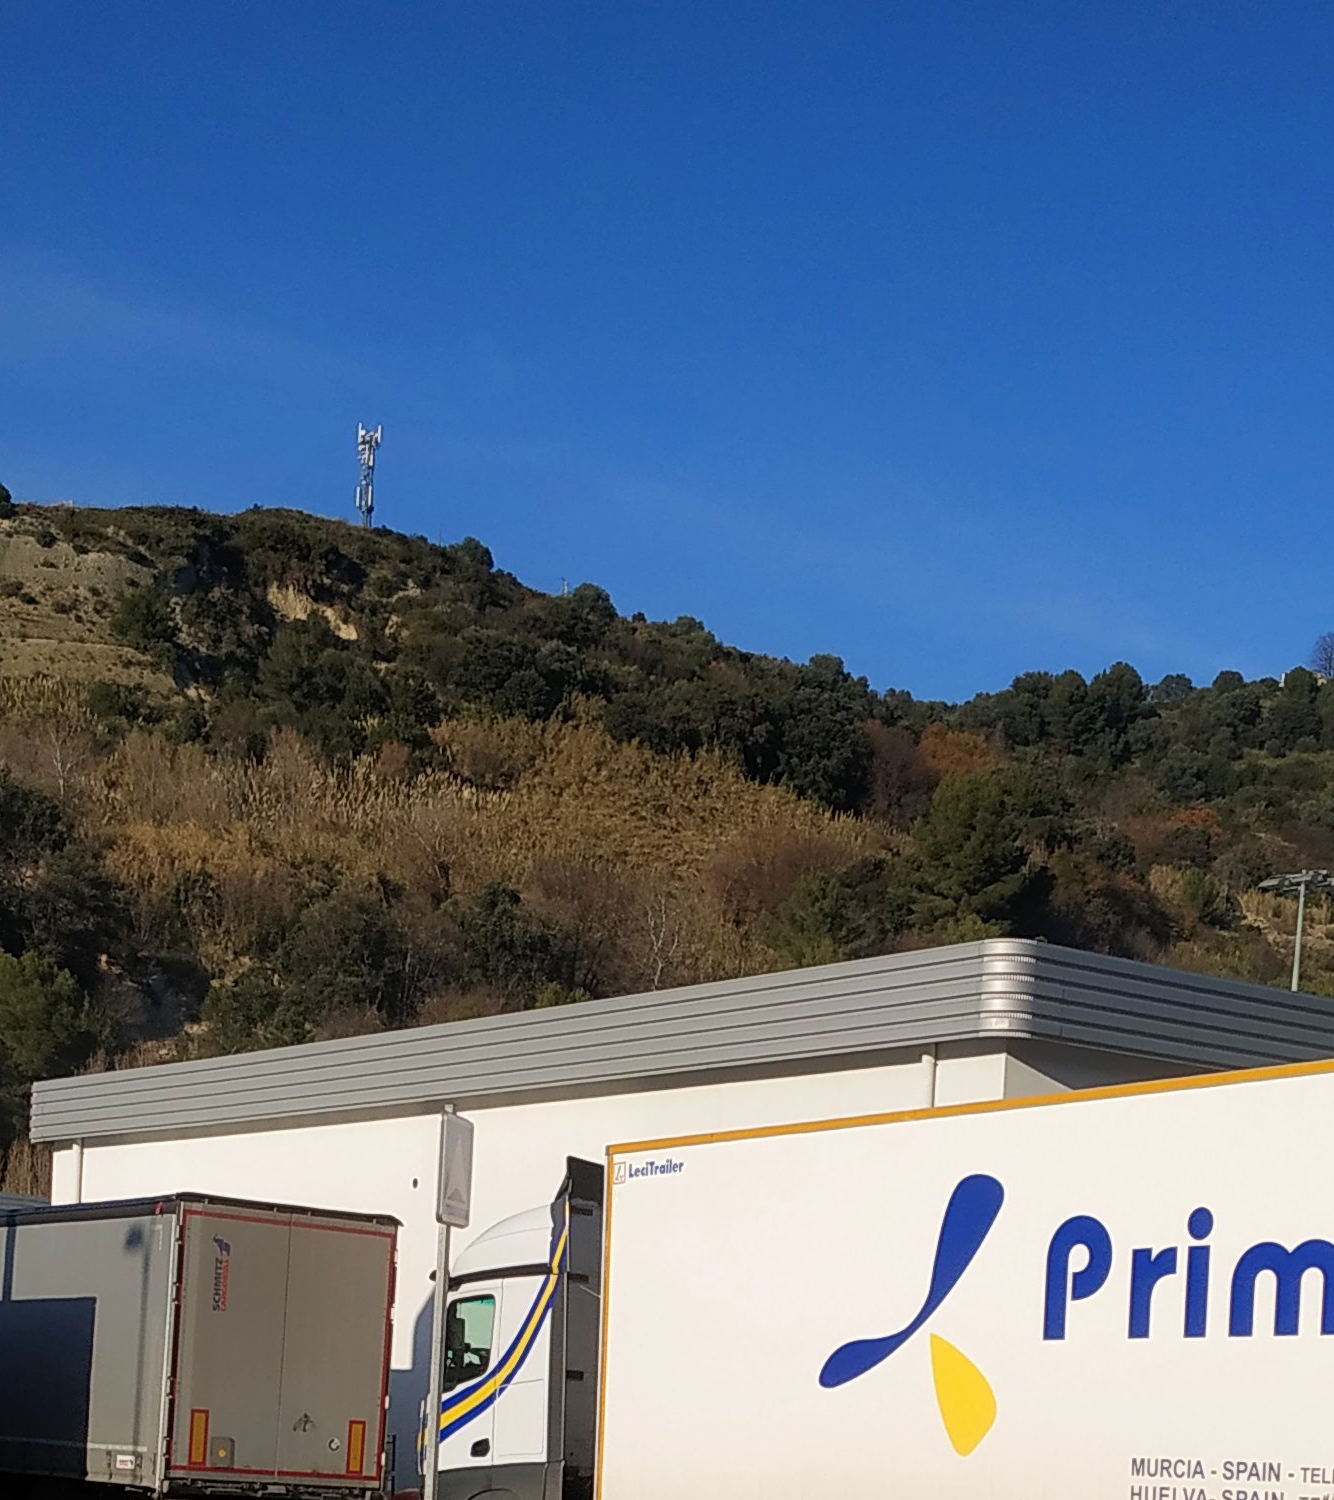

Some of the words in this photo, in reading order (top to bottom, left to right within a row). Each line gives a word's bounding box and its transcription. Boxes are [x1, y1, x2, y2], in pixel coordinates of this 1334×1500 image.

[628, 1159, 685, 1179] LeciTrailer
[212, 1257, 223, 1312] SCHMITZ
[1130, 1457, 1206, 1479] MURCIA
[1222, 1460, 1281, 1482] SPAIN
